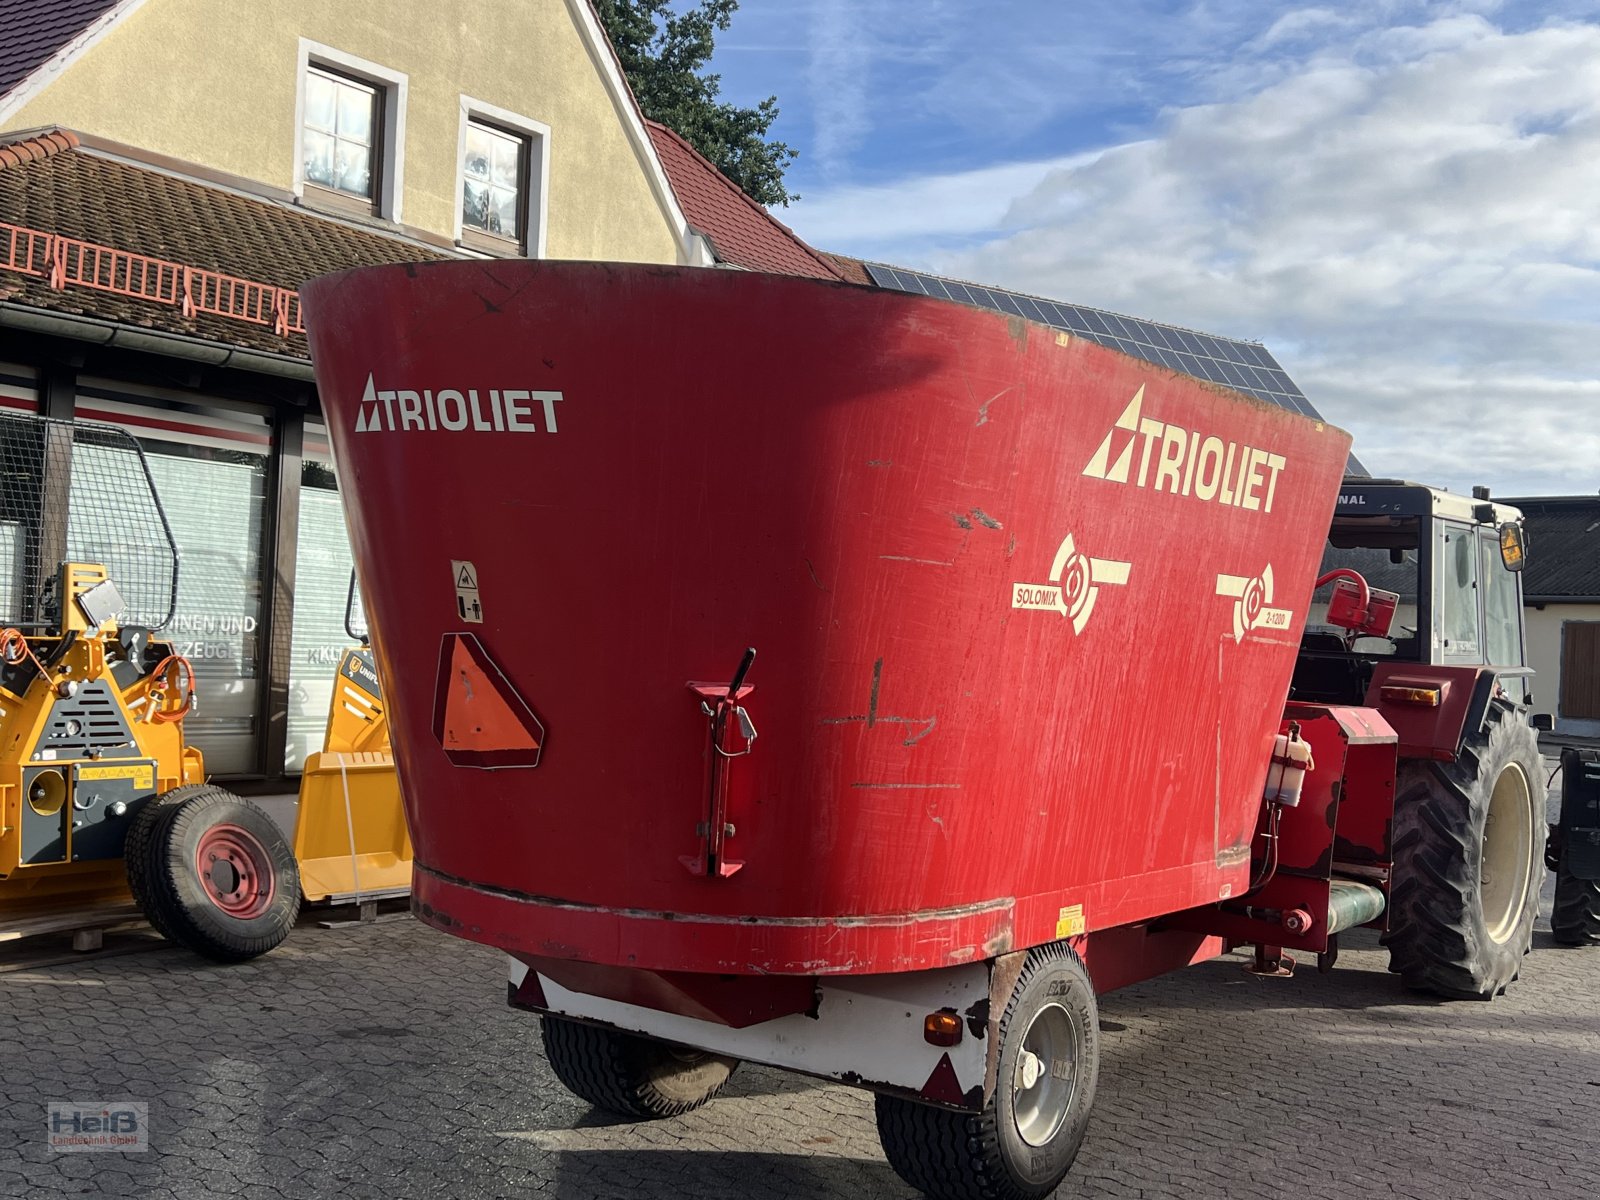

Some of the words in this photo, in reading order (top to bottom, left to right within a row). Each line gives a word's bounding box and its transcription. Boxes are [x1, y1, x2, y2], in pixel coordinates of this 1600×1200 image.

[377, 389, 564, 434] TRIOLIET
[1136, 417, 1287, 513] TRIOLIET
[1338, 495, 1366, 505] NAL
[1016, 587, 1059, 607] SOLOMIX
[221, 614, 256, 633] UND
[1265, 612, 1286, 626] 2-1200
